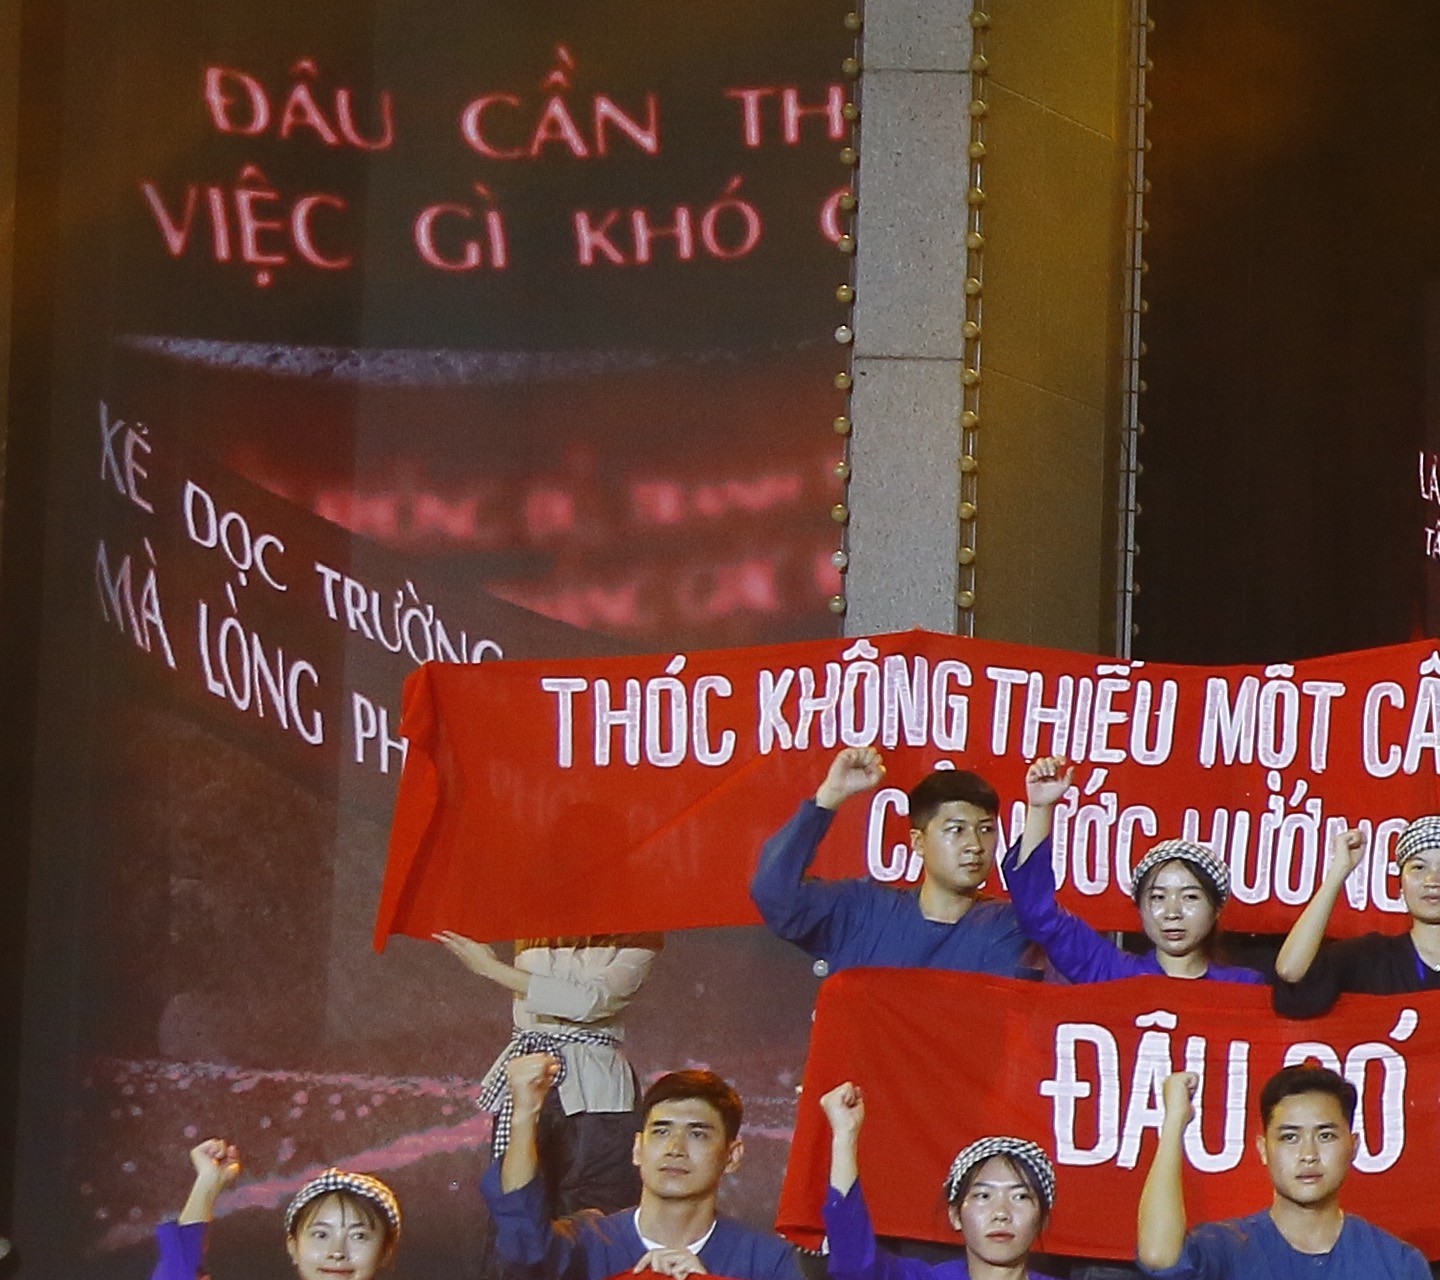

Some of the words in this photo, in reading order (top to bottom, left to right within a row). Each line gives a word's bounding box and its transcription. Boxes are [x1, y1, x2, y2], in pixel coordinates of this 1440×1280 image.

[204, 58, 394, 151] ĐÂU
[461, 43, 661, 159] CẦN
[139, 165, 353, 288] VIỆC
[413, 181, 509, 273] GÌ
[572, 174, 764, 268] KHÓ
[183, 478, 289, 591] DỌC
[95, 537, 178, 671] MÀ
[198, 581, 324, 746] LÒNG
[541, 655, 735, 769] THÓC
[758, 638, 972, 756] KHÔNG
[986, 660, 1177, 766] THIẾU
[1200, 663, 1346, 791] MỘT
[1039, 1009, 1250, 1174] ĐÂU
